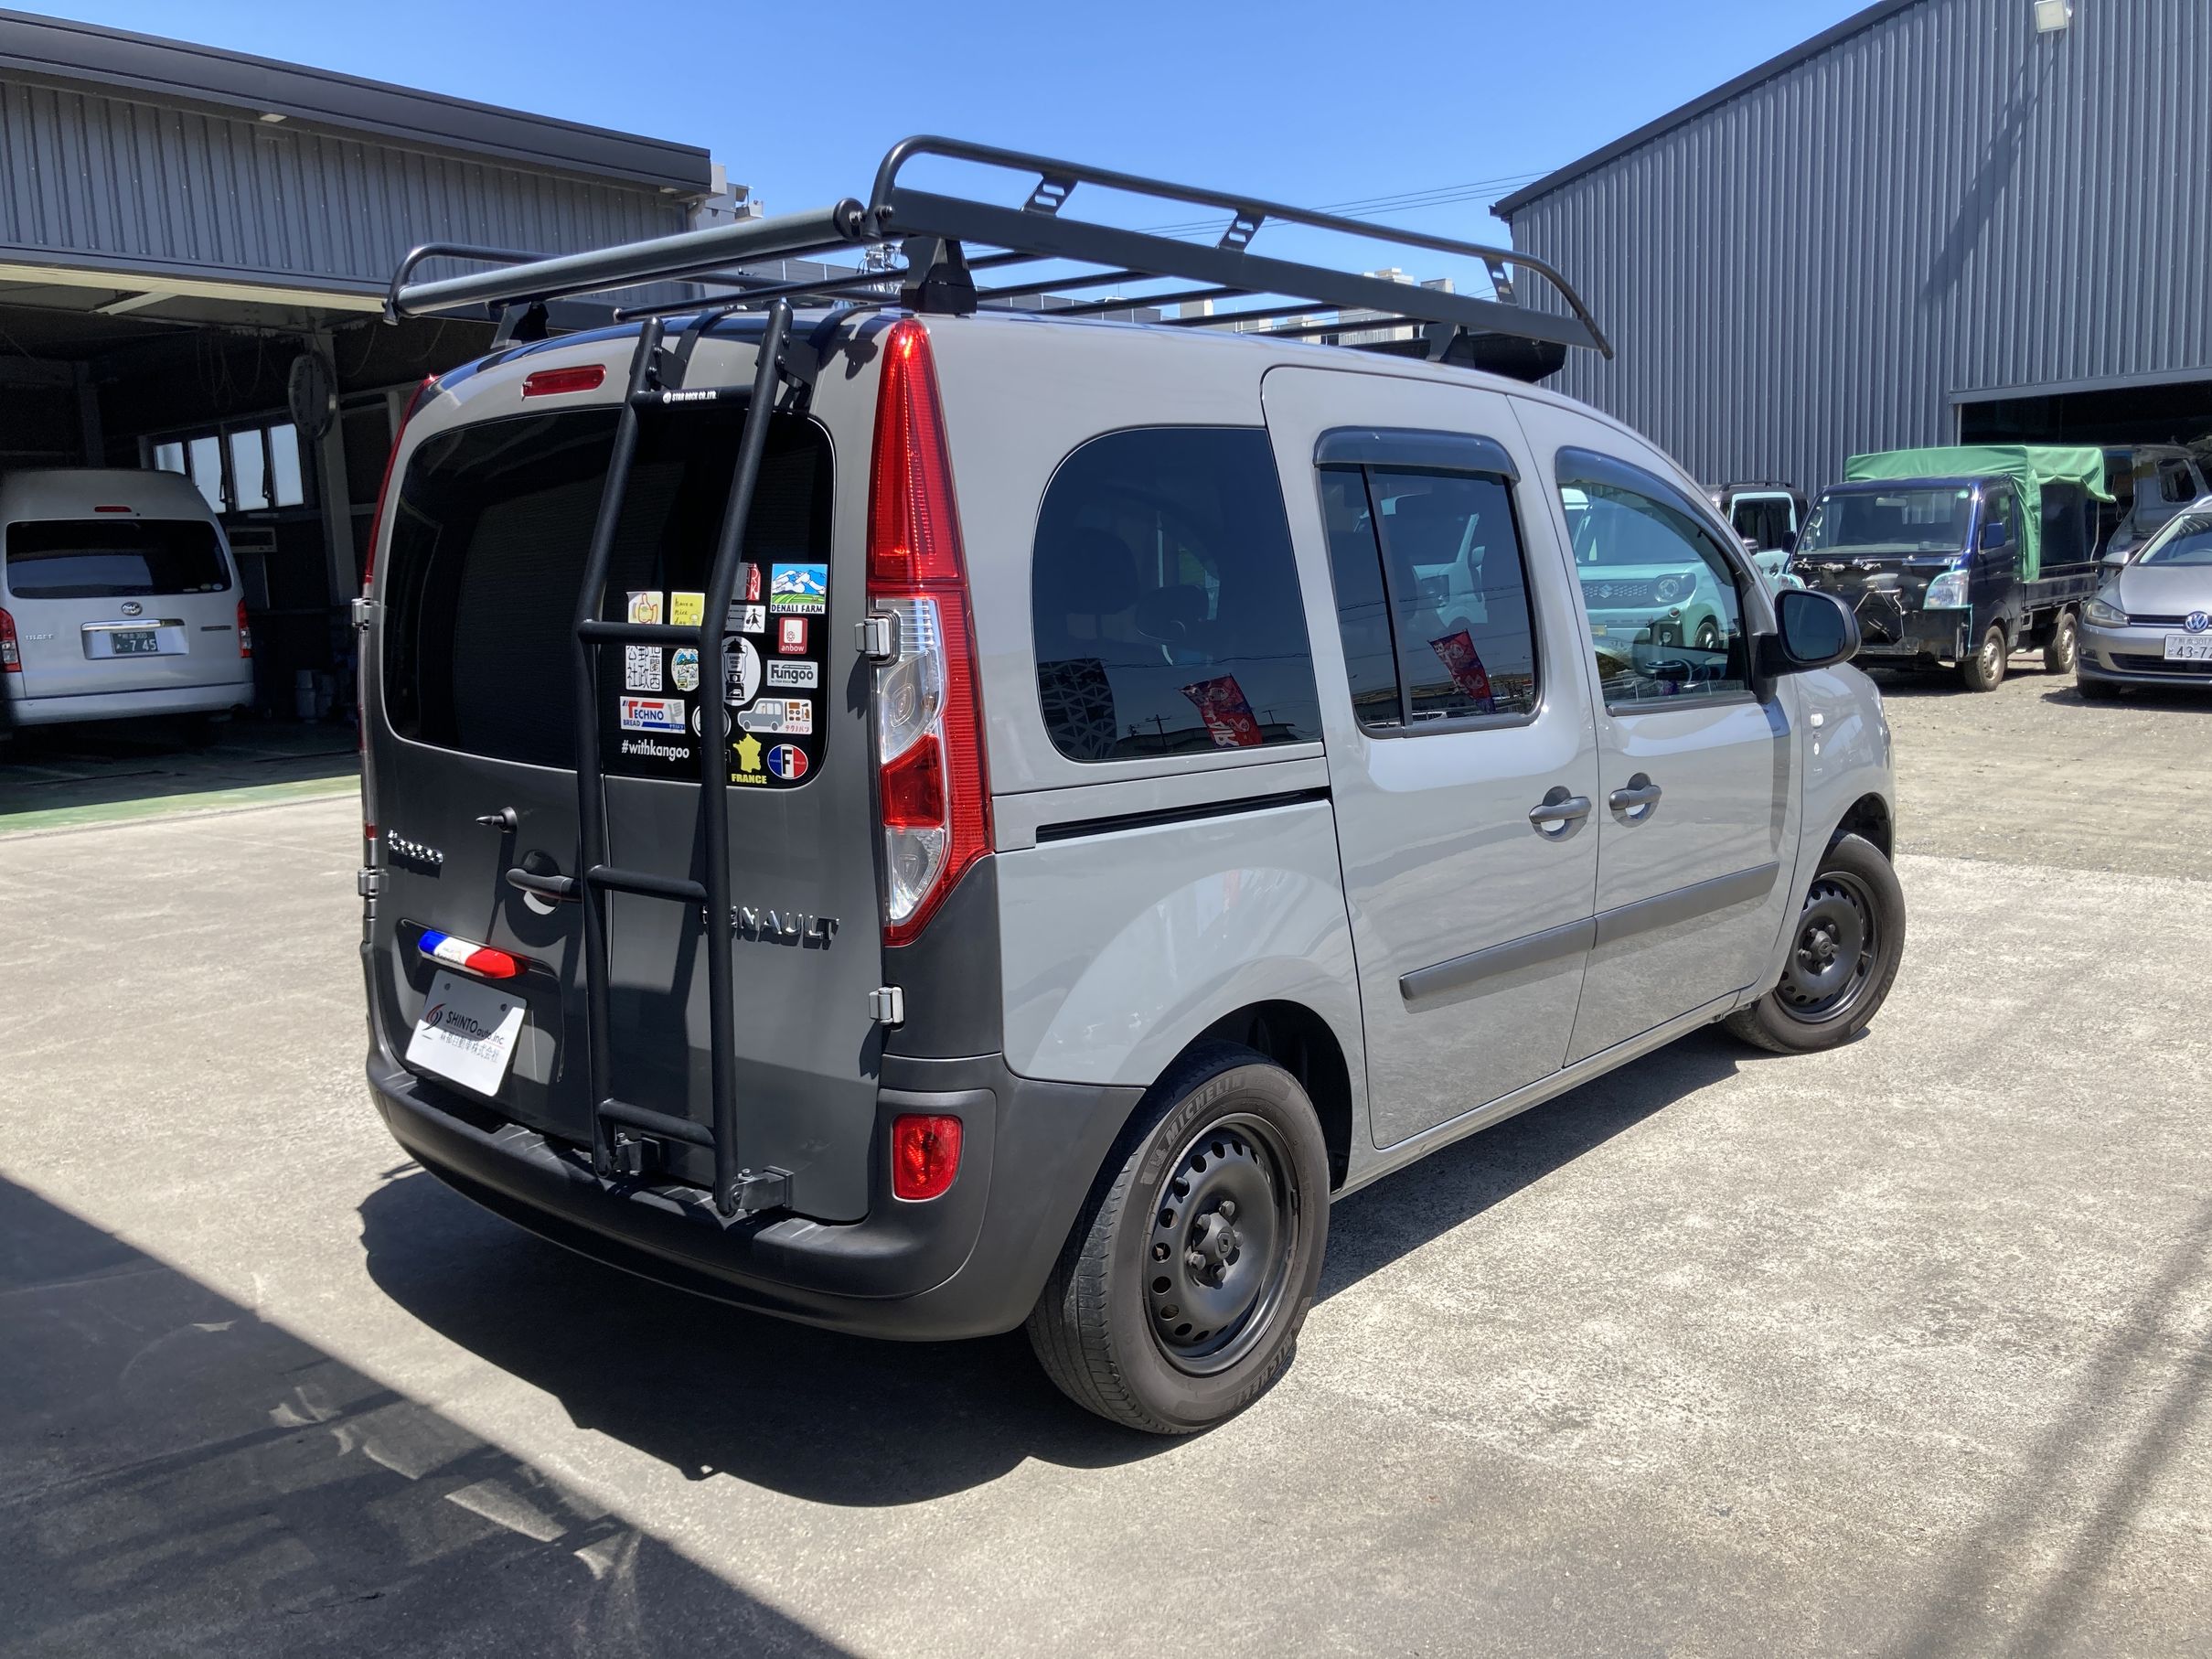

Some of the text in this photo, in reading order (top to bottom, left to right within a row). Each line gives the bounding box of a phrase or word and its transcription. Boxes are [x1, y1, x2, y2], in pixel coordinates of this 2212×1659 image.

[771, 605, 823, 613] DENALI FARM
[781, 644, 805, 652] anbow
[771, 664, 814, 684] Fungoo
[628, 701, 664, 721] TECHNO
[622, 739, 689, 762] #withkangoo
[782, 749, 793, 775] F
[732, 774, 767, 784] FRANCE
[446, 1011, 478, 1033] SHINTO
[1165, 1073, 1245, 1145] MICHELIN
